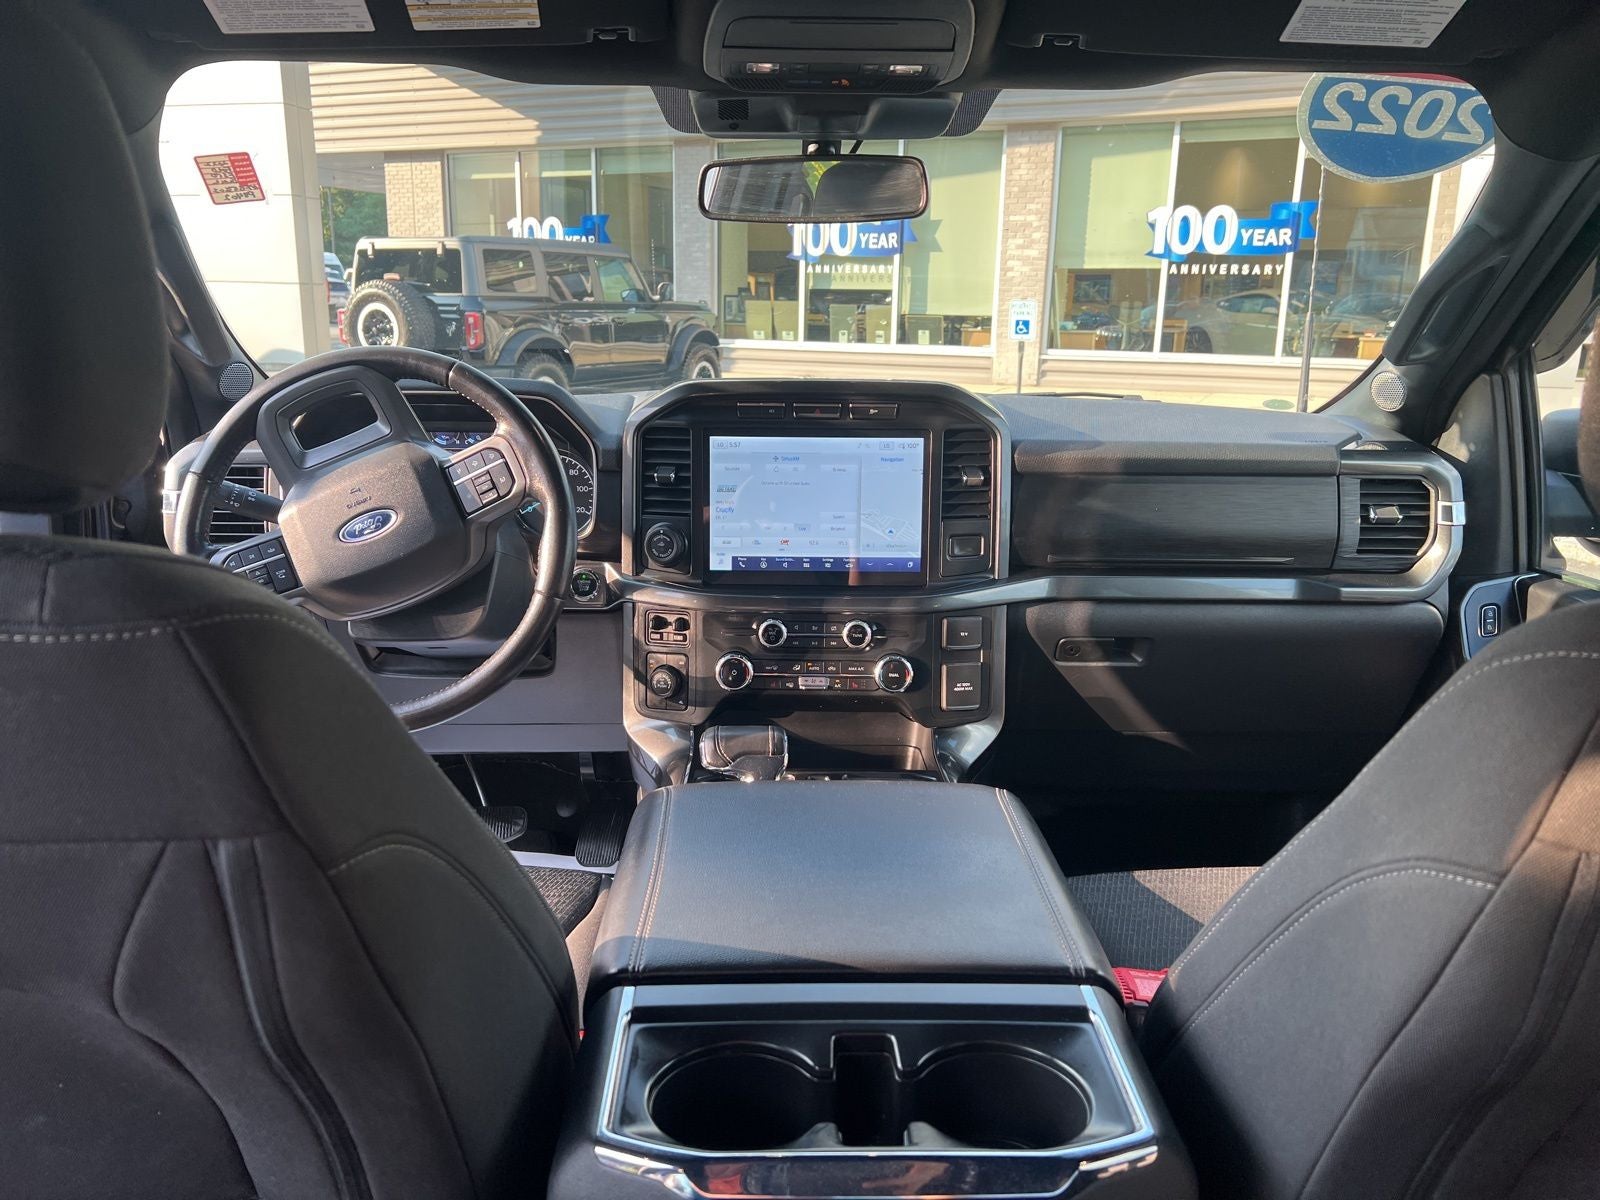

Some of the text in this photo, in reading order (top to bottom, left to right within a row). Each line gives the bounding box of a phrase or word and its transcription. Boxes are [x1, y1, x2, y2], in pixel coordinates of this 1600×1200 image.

[506, 216, 564, 241] 100
[1147, 204, 1293, 255] 100 YEAR
[787, 222, 898, 257] 100 YEAR
[806, 264, 893, 274] ANNIVERSARY
[1168, 263, 1284, 276] ANNIVERSARY
[568, 468, 580, 476] 80
[576, 485, 589, 493] 100
